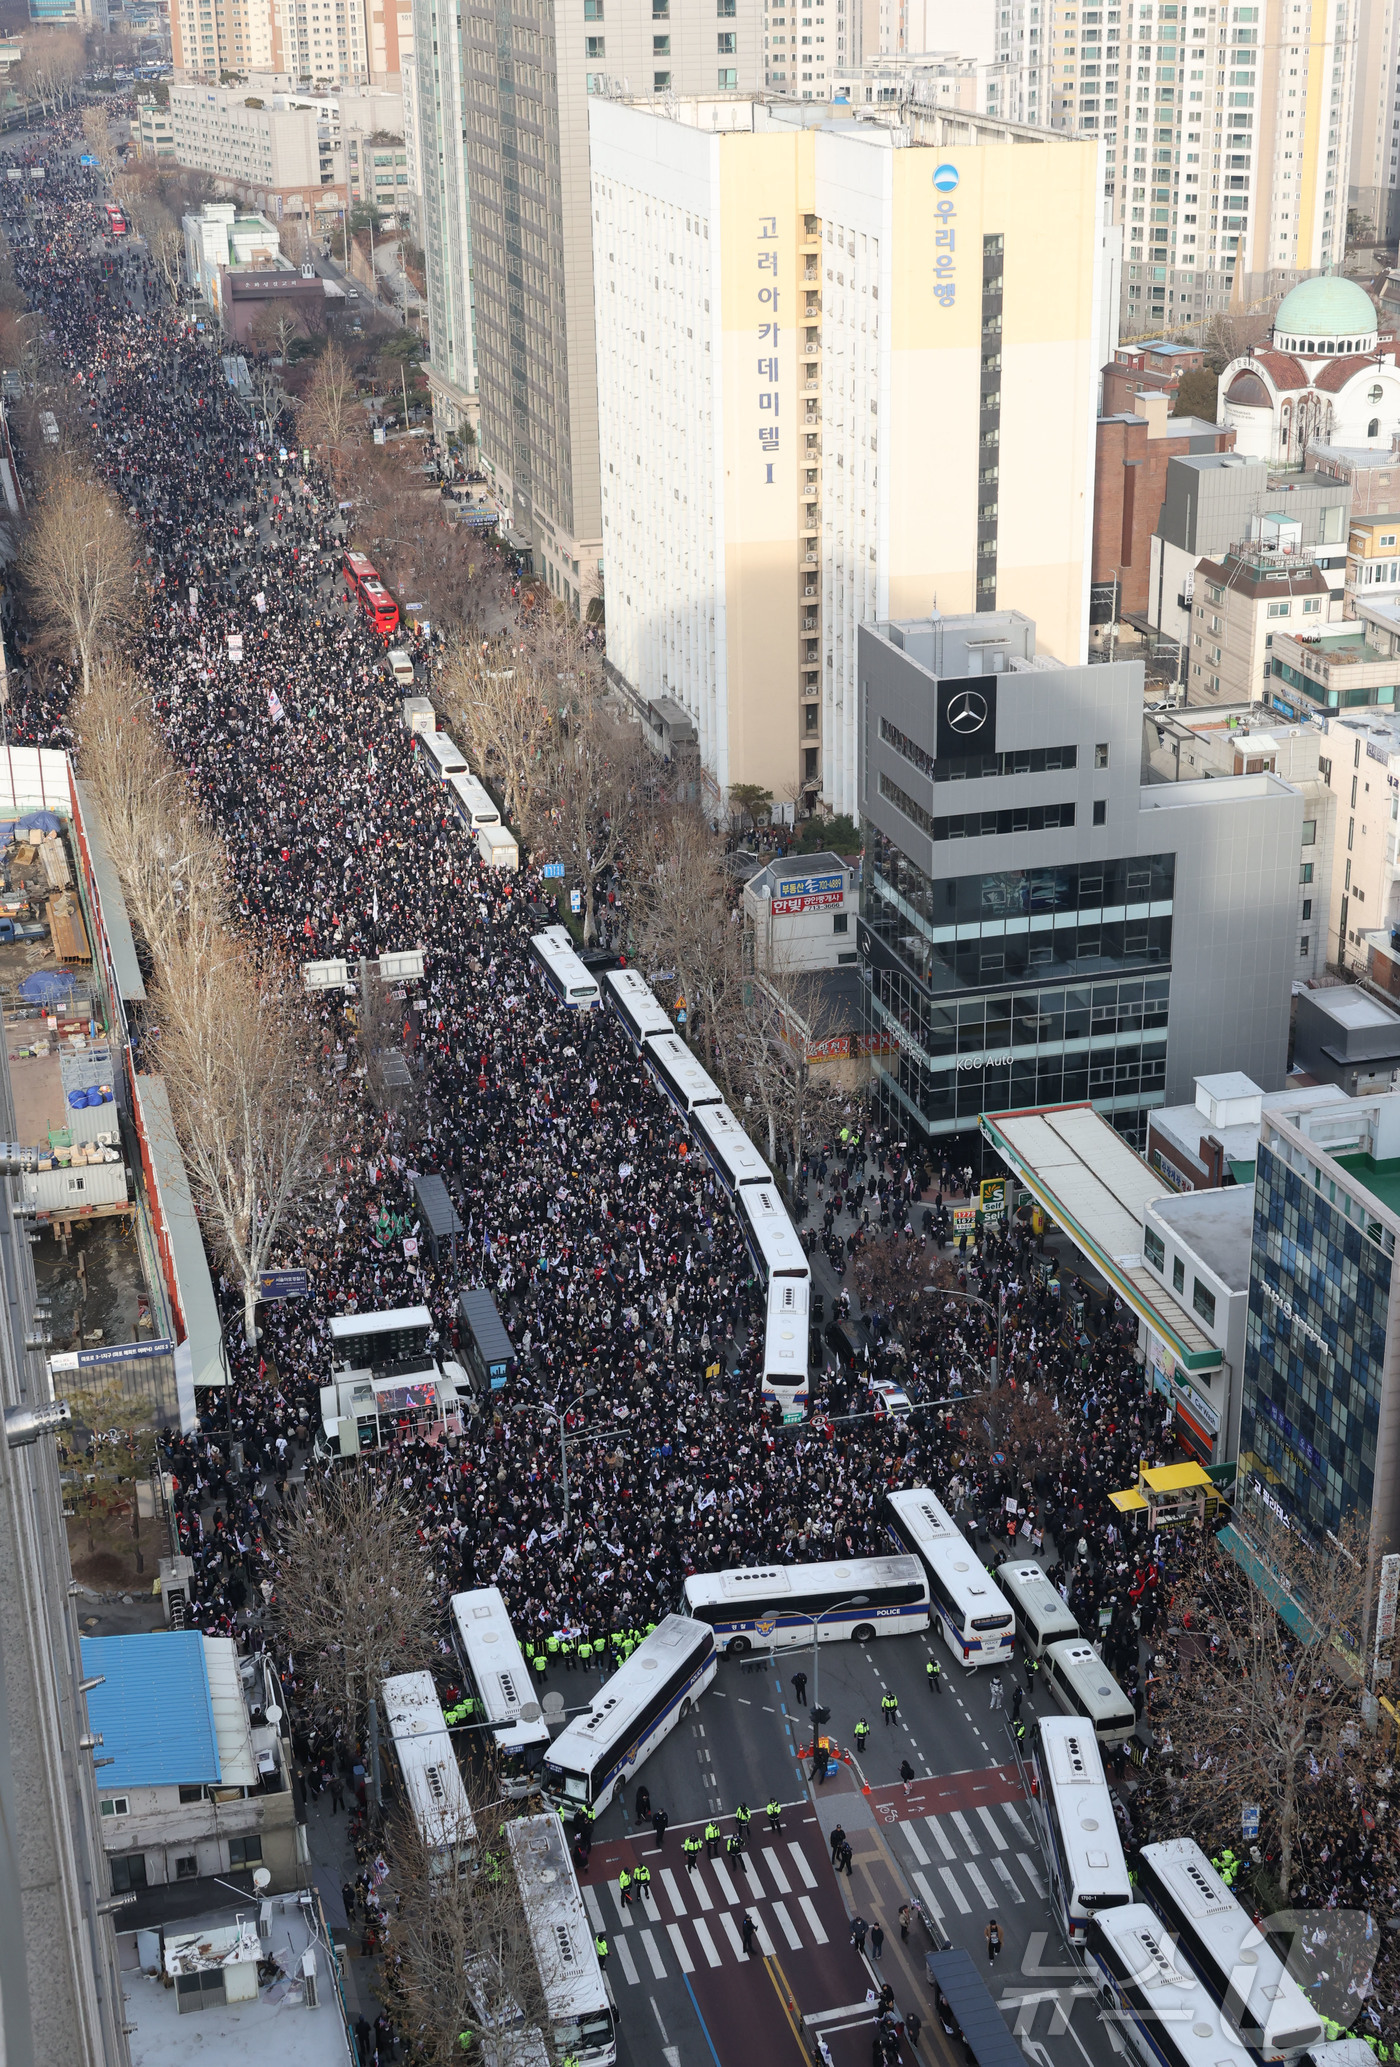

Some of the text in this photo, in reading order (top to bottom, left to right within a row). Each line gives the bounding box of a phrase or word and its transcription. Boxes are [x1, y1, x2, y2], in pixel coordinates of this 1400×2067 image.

[933, 200, 957, 307] 우리은행
[757, 216, 781, 452] 고려아카데미텔
[782, 882, 804, 894] 부동산
[773, 894, 840, 914] 한빛 공인중개사
[956, 1055, 1014, 1071] KCC Auto
[985, 1203, 1001, 1211] Self
[984, 1211, 1005, 1221] Self
[1195, 1398, 1216, 1426] Car Wash
[1263, 1488, 1290, 1529] 필라테스
[876, 1608, 901, 1617] POLICE
[731, 1623, 747, 1631] 경찰
[690, 1667, 703, 1685] POLICE
